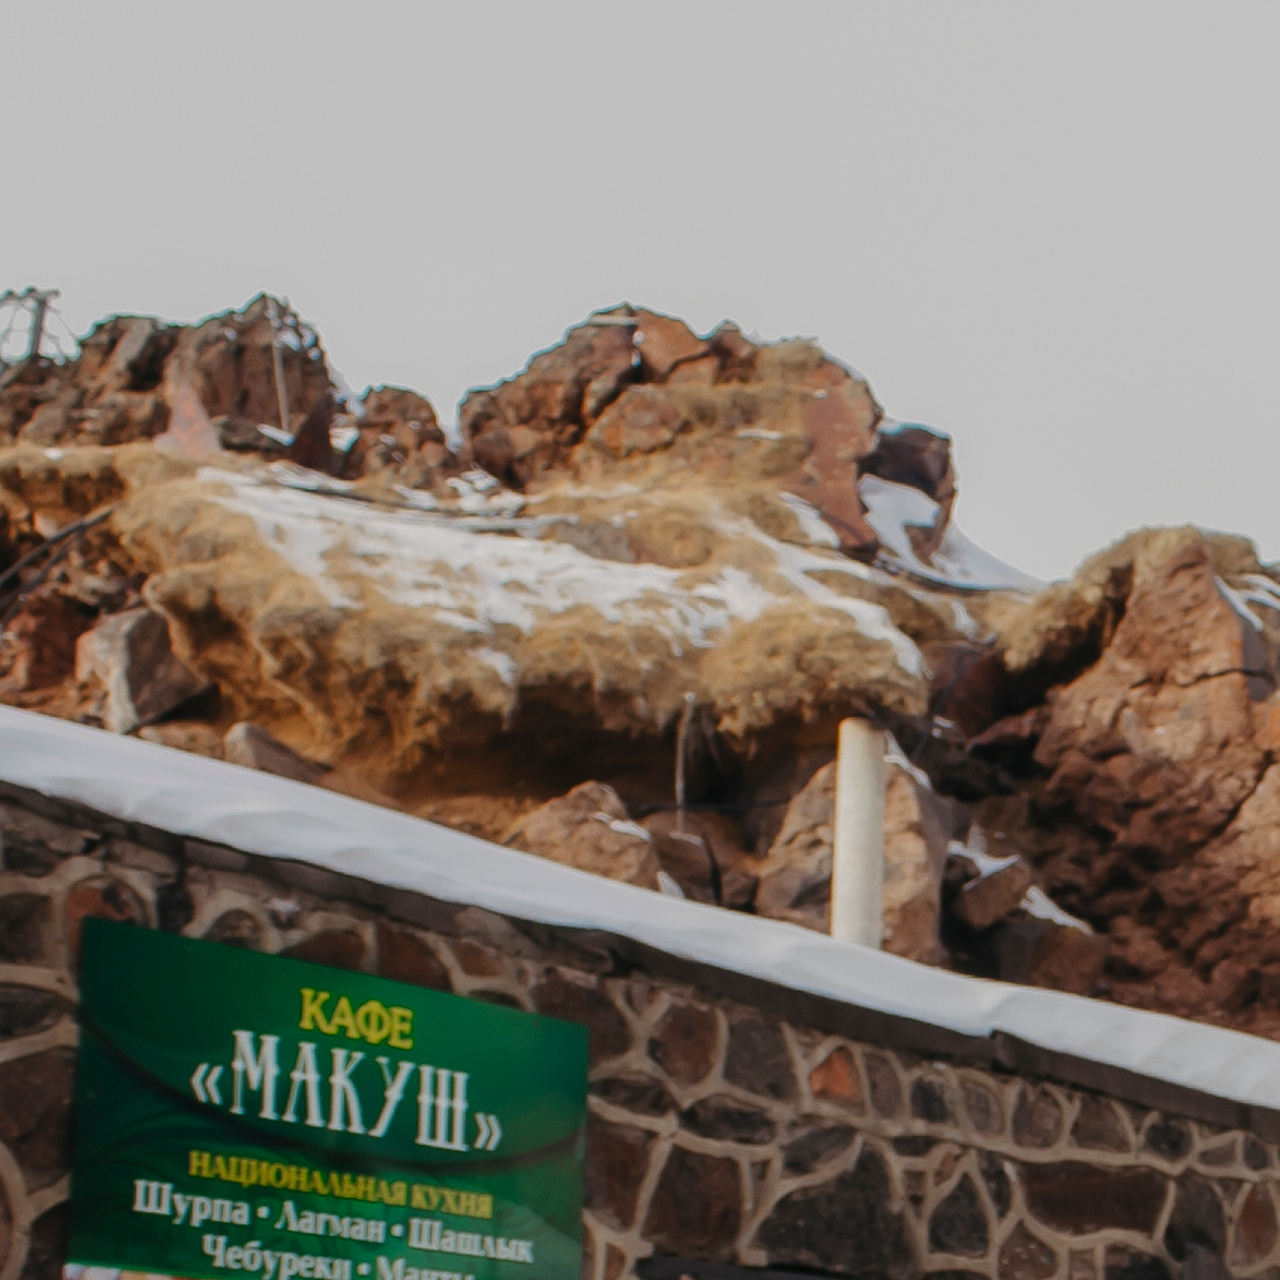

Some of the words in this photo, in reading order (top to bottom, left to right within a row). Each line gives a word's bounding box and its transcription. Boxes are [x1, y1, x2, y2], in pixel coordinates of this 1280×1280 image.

[299, 987, 414, 1050] КАФЕ
[189, 1150, 406, 1206] НАЦИОНАЛЬНАЯ
[411, 1186, 493, 1219] КУХНЯ
[133, 1179, 249, 1228] Шурпа
[274, 1201, 386, 1244] Лагман
[408, 1217, 534, 1264] Шашлык
